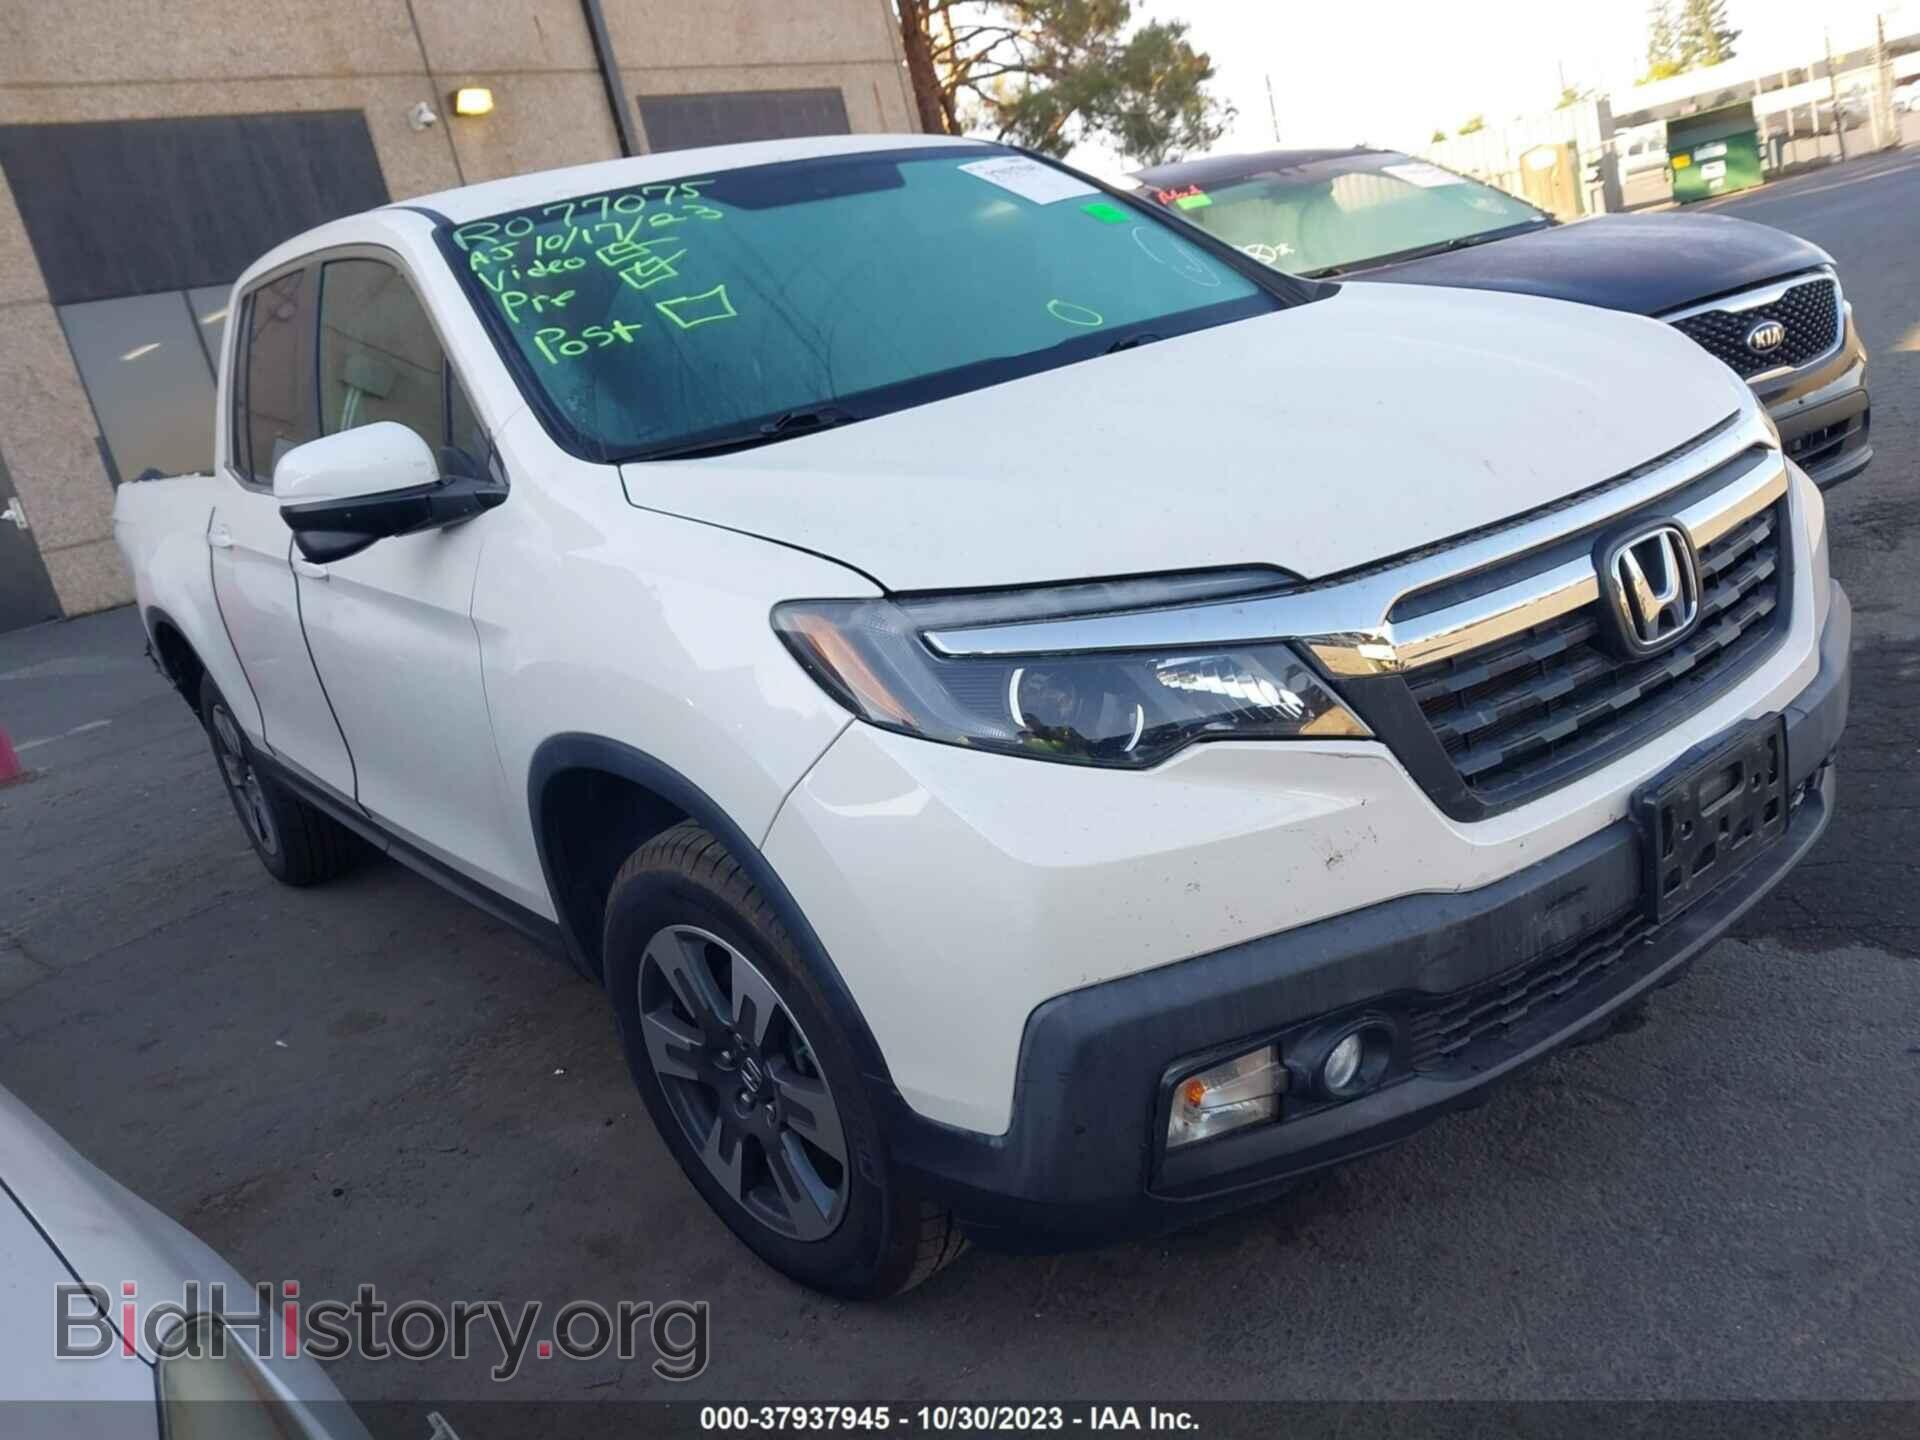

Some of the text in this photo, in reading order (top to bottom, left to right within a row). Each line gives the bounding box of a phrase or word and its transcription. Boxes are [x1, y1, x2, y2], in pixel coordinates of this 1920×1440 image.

[453, 180, 716, 250] RO 77075
[536, 204, 723, 256] 10/17/23
[478, 256, 586, 292] Video
[501, 290, 576, 323] Pre
[534, 320, 643, 364] Post
[1755, 326, 1780, 349] KIA
